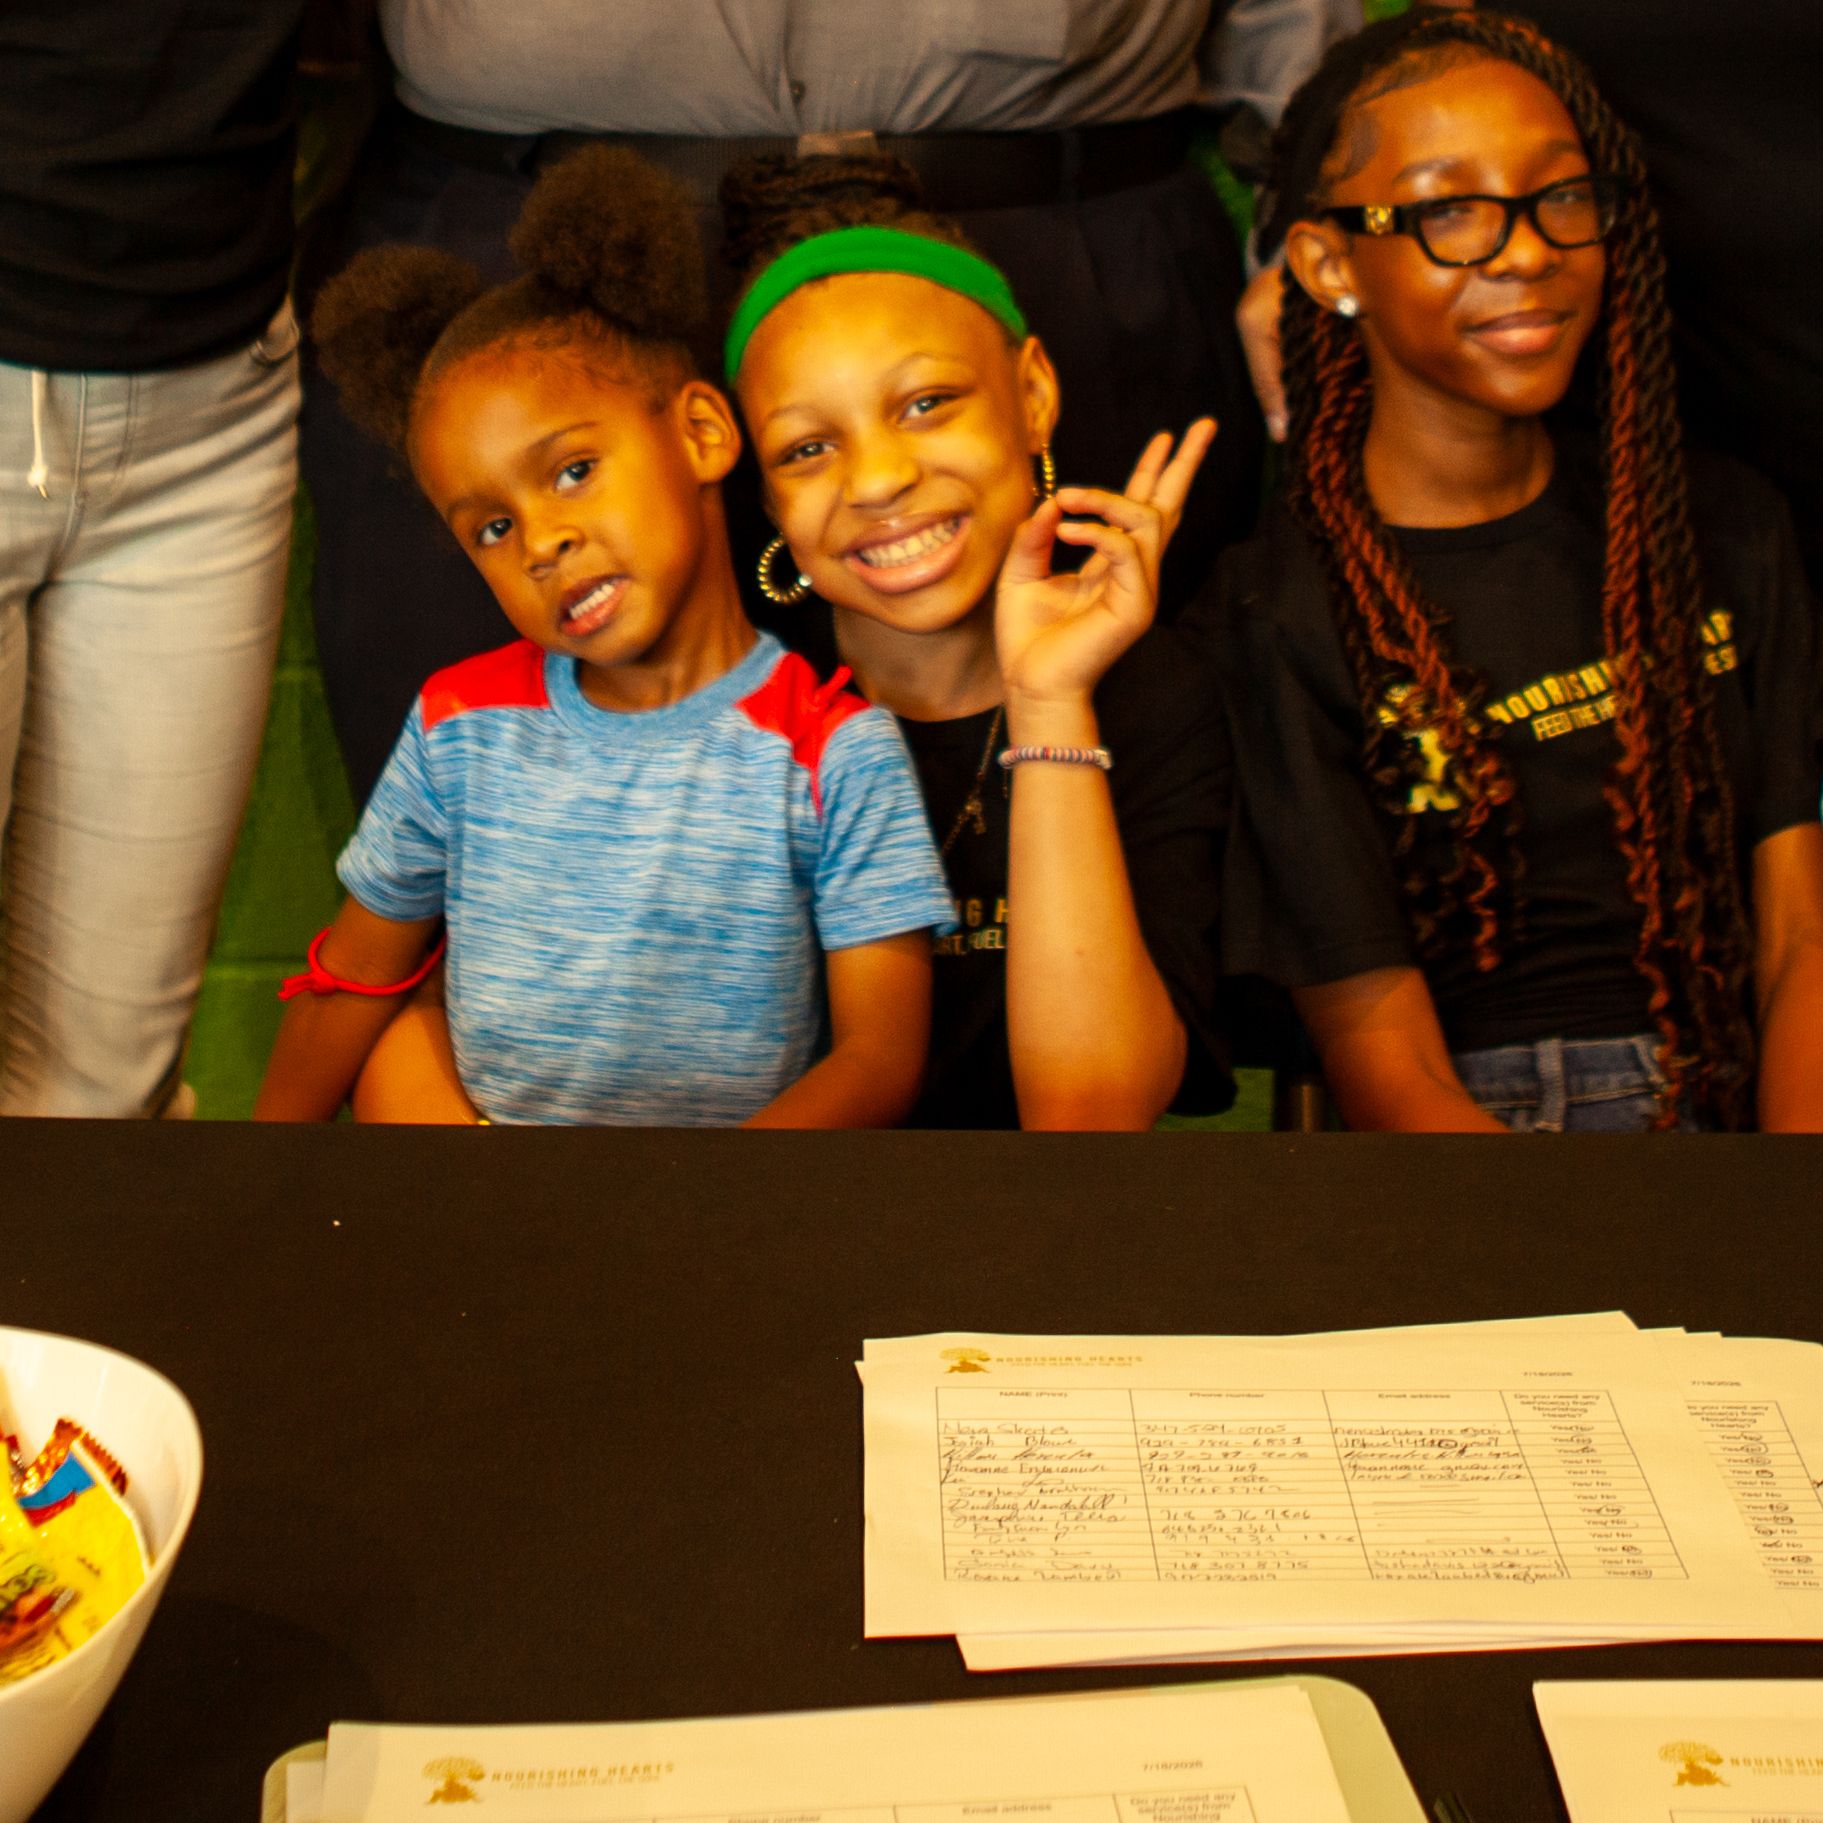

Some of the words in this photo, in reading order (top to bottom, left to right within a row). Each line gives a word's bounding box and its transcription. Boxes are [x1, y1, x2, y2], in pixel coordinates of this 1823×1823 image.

[998, 1390, 1034, 1398] NAME
[1188, 1391, 1224, 1399] Phone
[1225, 1392, 1266, 1400] number
[491, 1765, 600, 1783] NOURISHING
[606, 1761, 676, 1777] HEARTS
